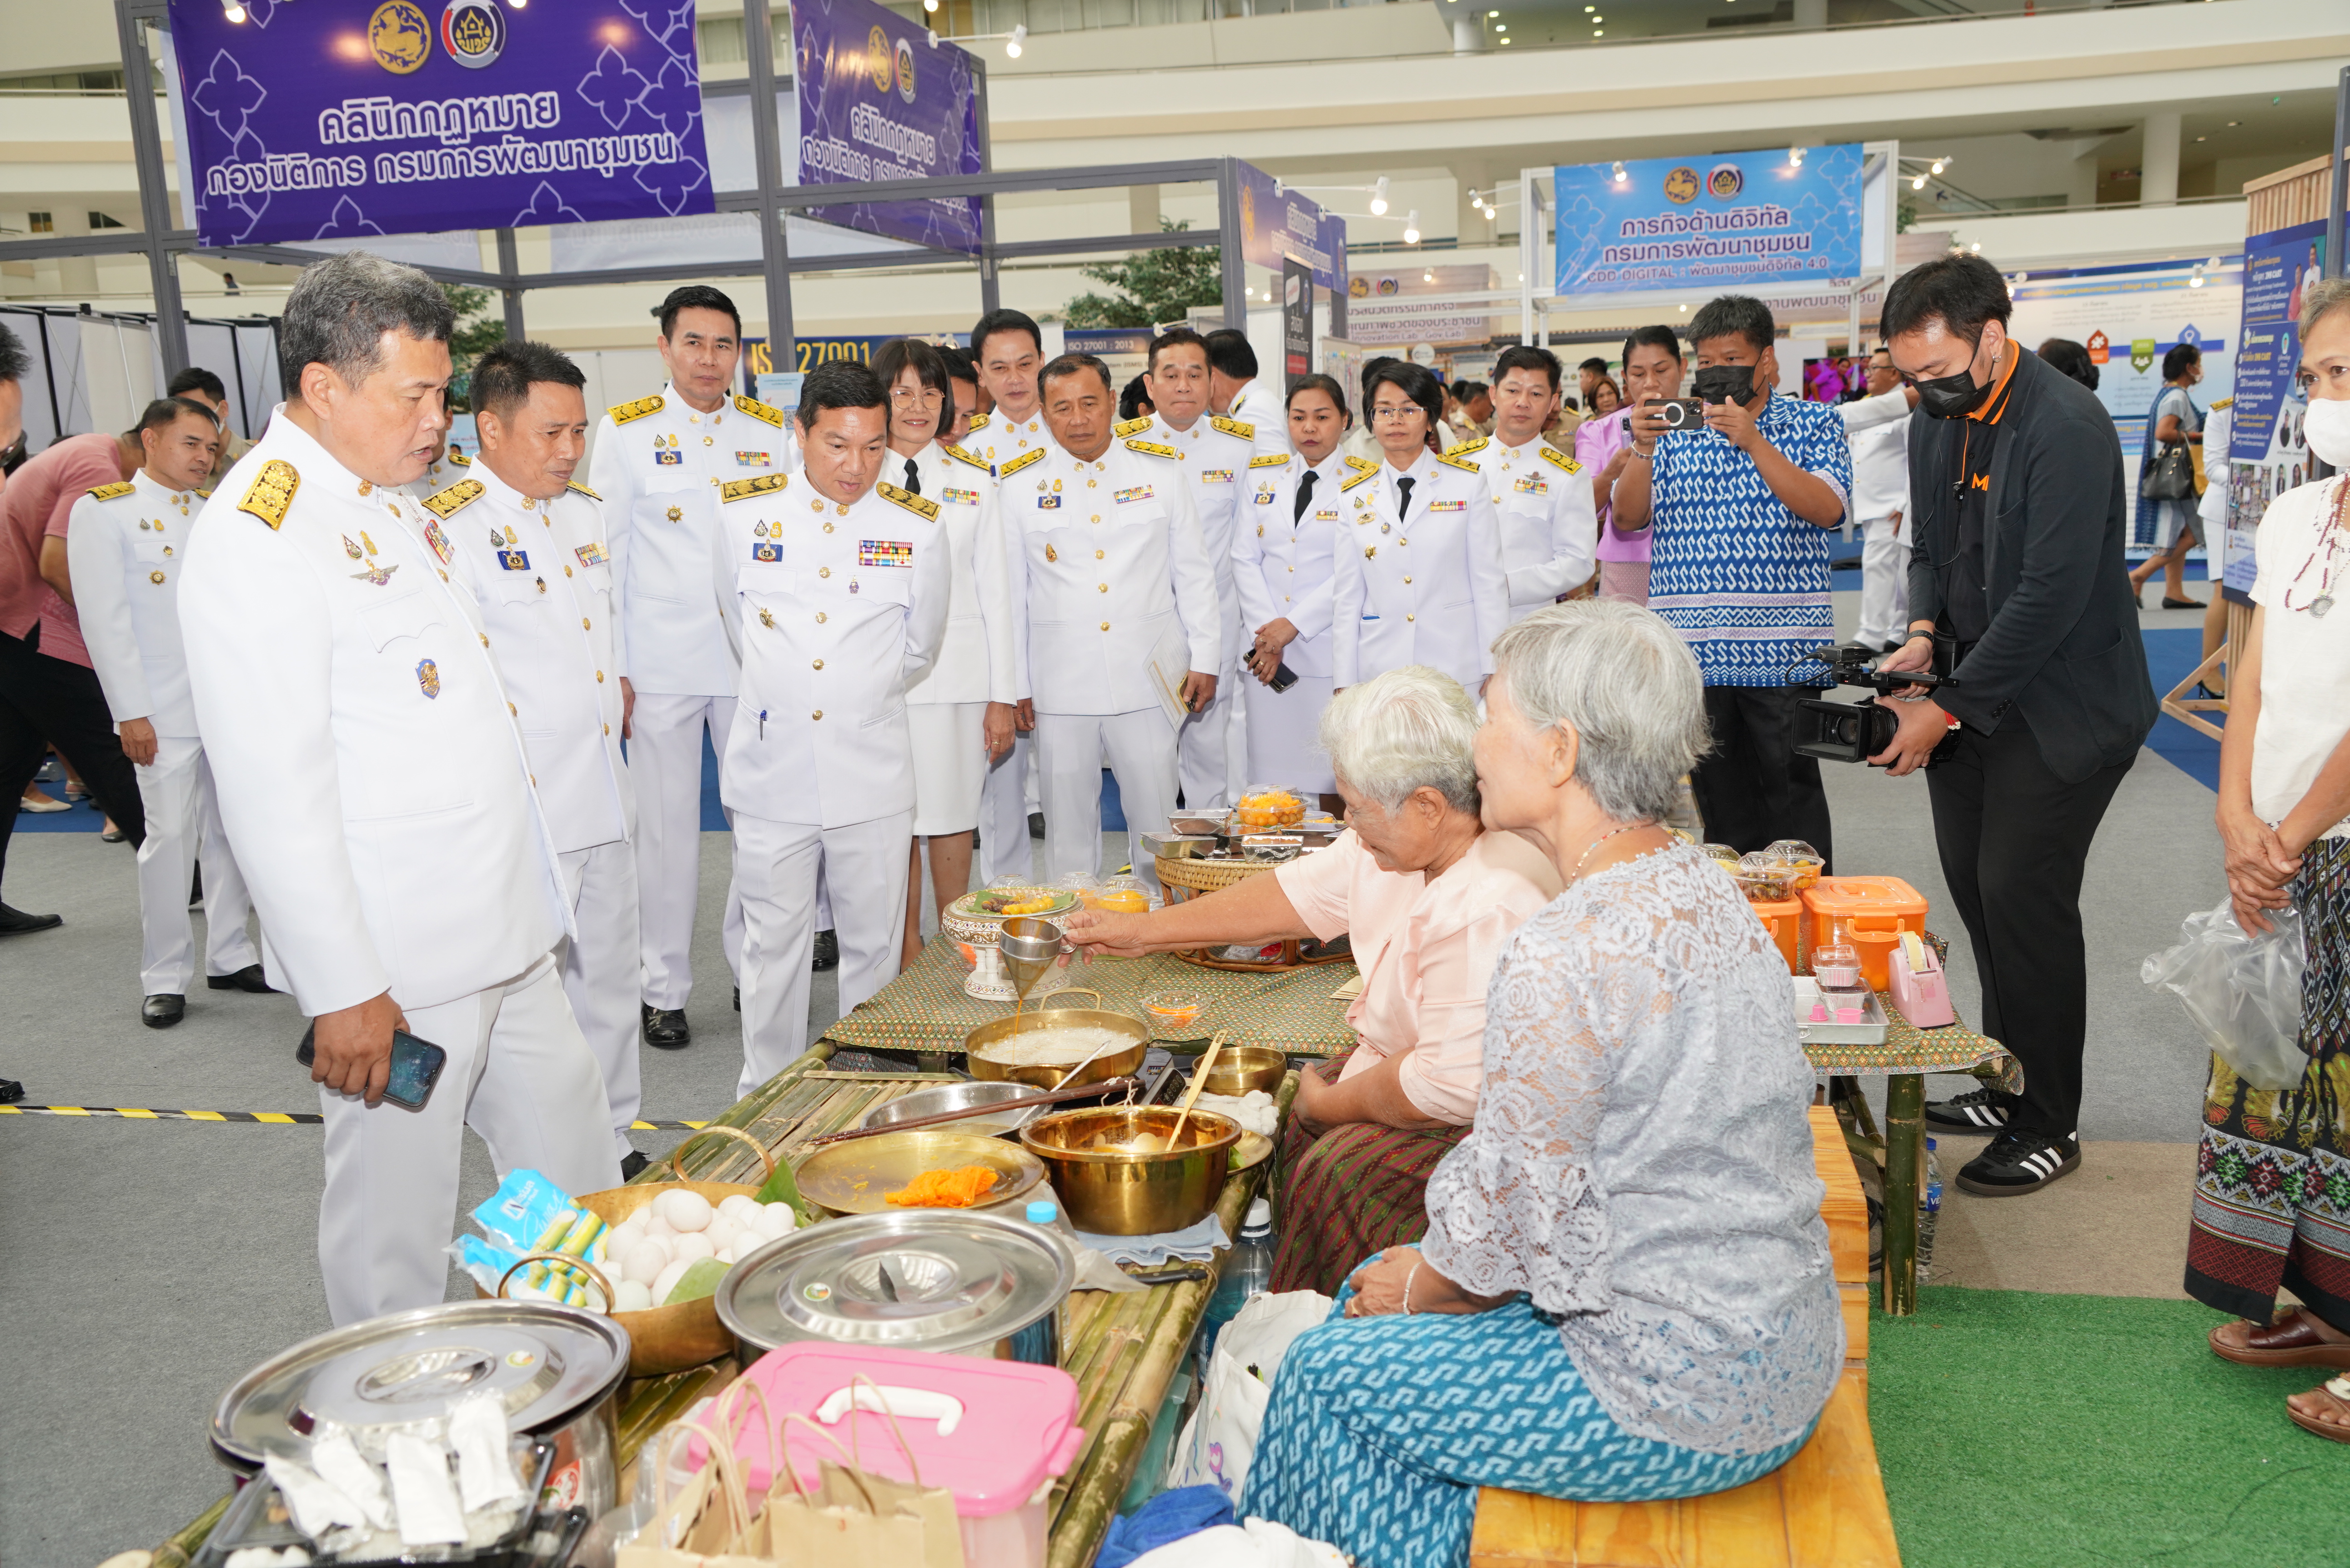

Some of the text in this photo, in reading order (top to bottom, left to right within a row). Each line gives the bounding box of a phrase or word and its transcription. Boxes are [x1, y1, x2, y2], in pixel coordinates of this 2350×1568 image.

[318, 91, 561, 145] คลินิกกฎหมาย
[850, 102, 936, 166] คลินิกกฎหมาย
[207, 132, 676, 196] กองนิติการ กรมการพัฒนาชุมชน
[802, 136, 872, 182] กองนิติการ
[1620, 204, 1791, 239] ภารกิจด้านดิจิทัล
[1603, 232, 1812, 264] กรมการพัฒนาชุมชน
[1587, 271, 1616, 283] CDD
[1622, 265, 1677, 281] DIGITAL
[1689, 258, 1803, 278] พัฒนาชุมชนดิจิทัล
[1806, 256, 1828, 270] 4.0
[751, 342, 870, 375] IS 27001
[1068, 342, 1082, 351] ISO
[1084, 341, 1107, 351] 27001
[1115, 340, 1135, 350] 2013
